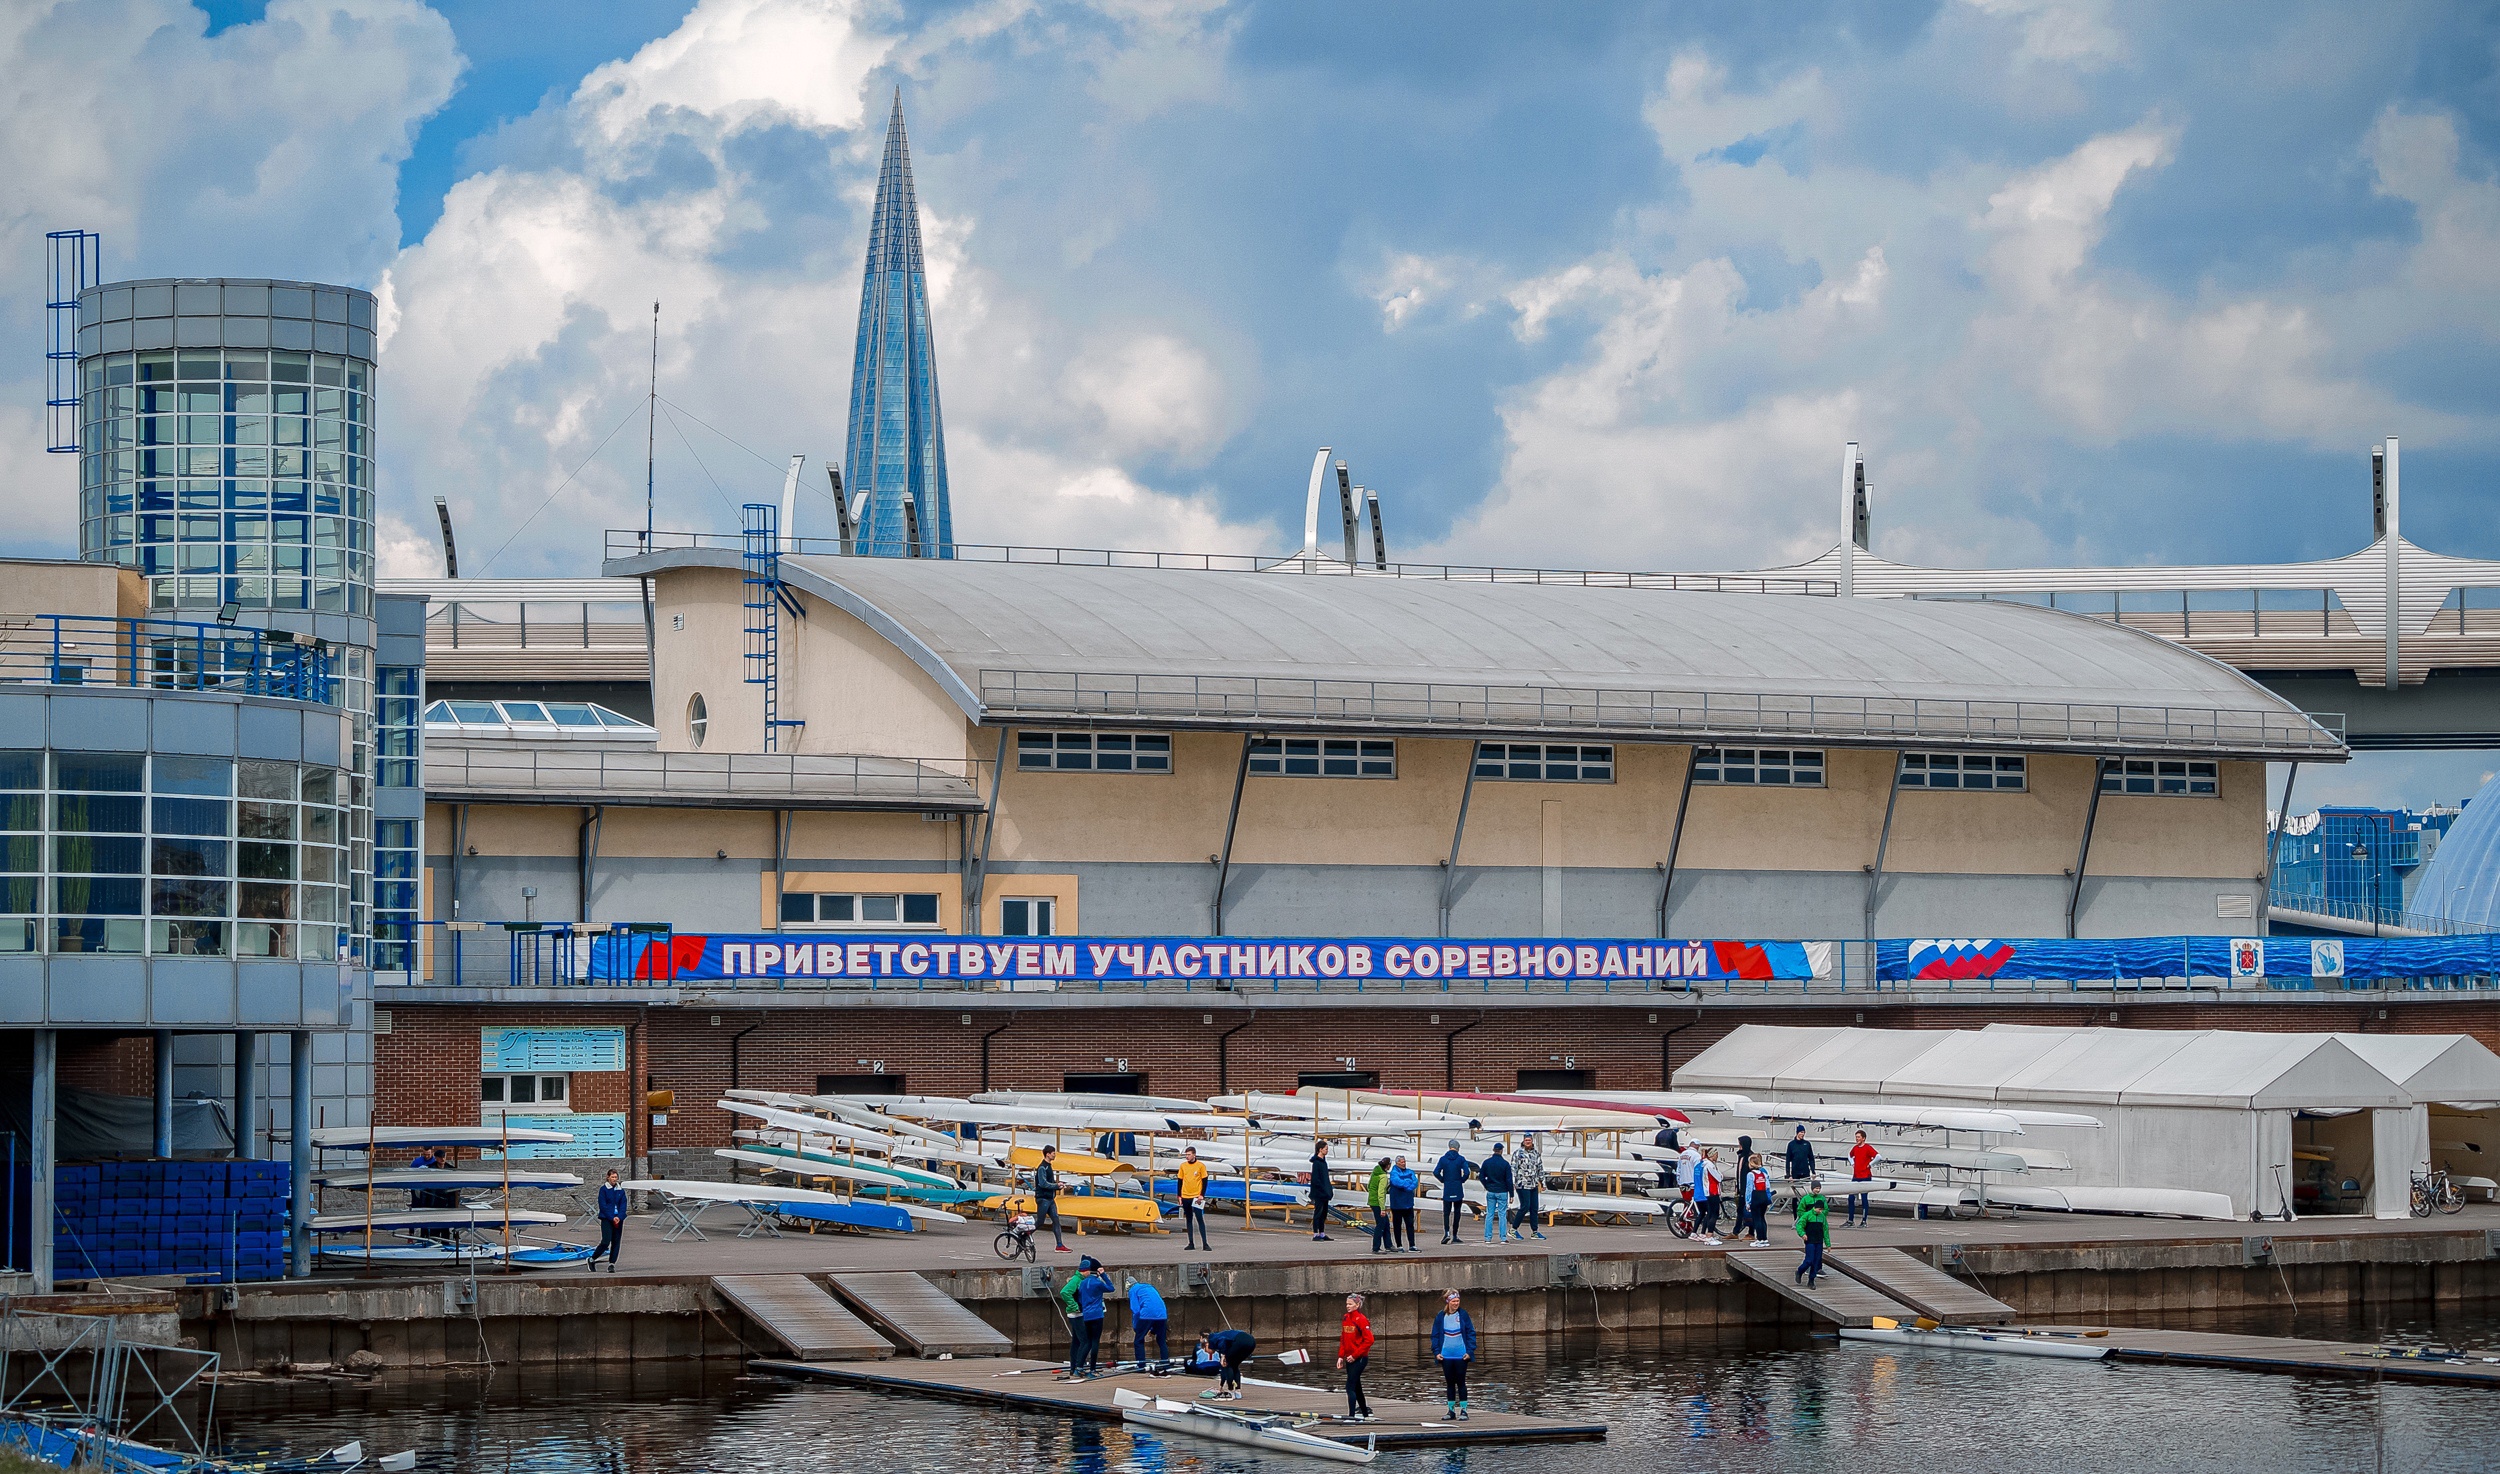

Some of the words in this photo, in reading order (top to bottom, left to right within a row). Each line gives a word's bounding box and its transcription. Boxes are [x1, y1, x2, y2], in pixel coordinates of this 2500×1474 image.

[722, 942, 1076, 976] ПРИВЕТСТВУЕМ
[1088, 944, 1373, 977] УЧАСТНИКОВ
[1384, 940, 1708, 977] СОРЕВНОВАНИЙ
[875, 1060, 883, 1073] 2
[1119, 1059, 1127, 1071] 3
[1346, 1057, 1354, 1070] 4
[1566, 1056, 1574, 1069] 5
